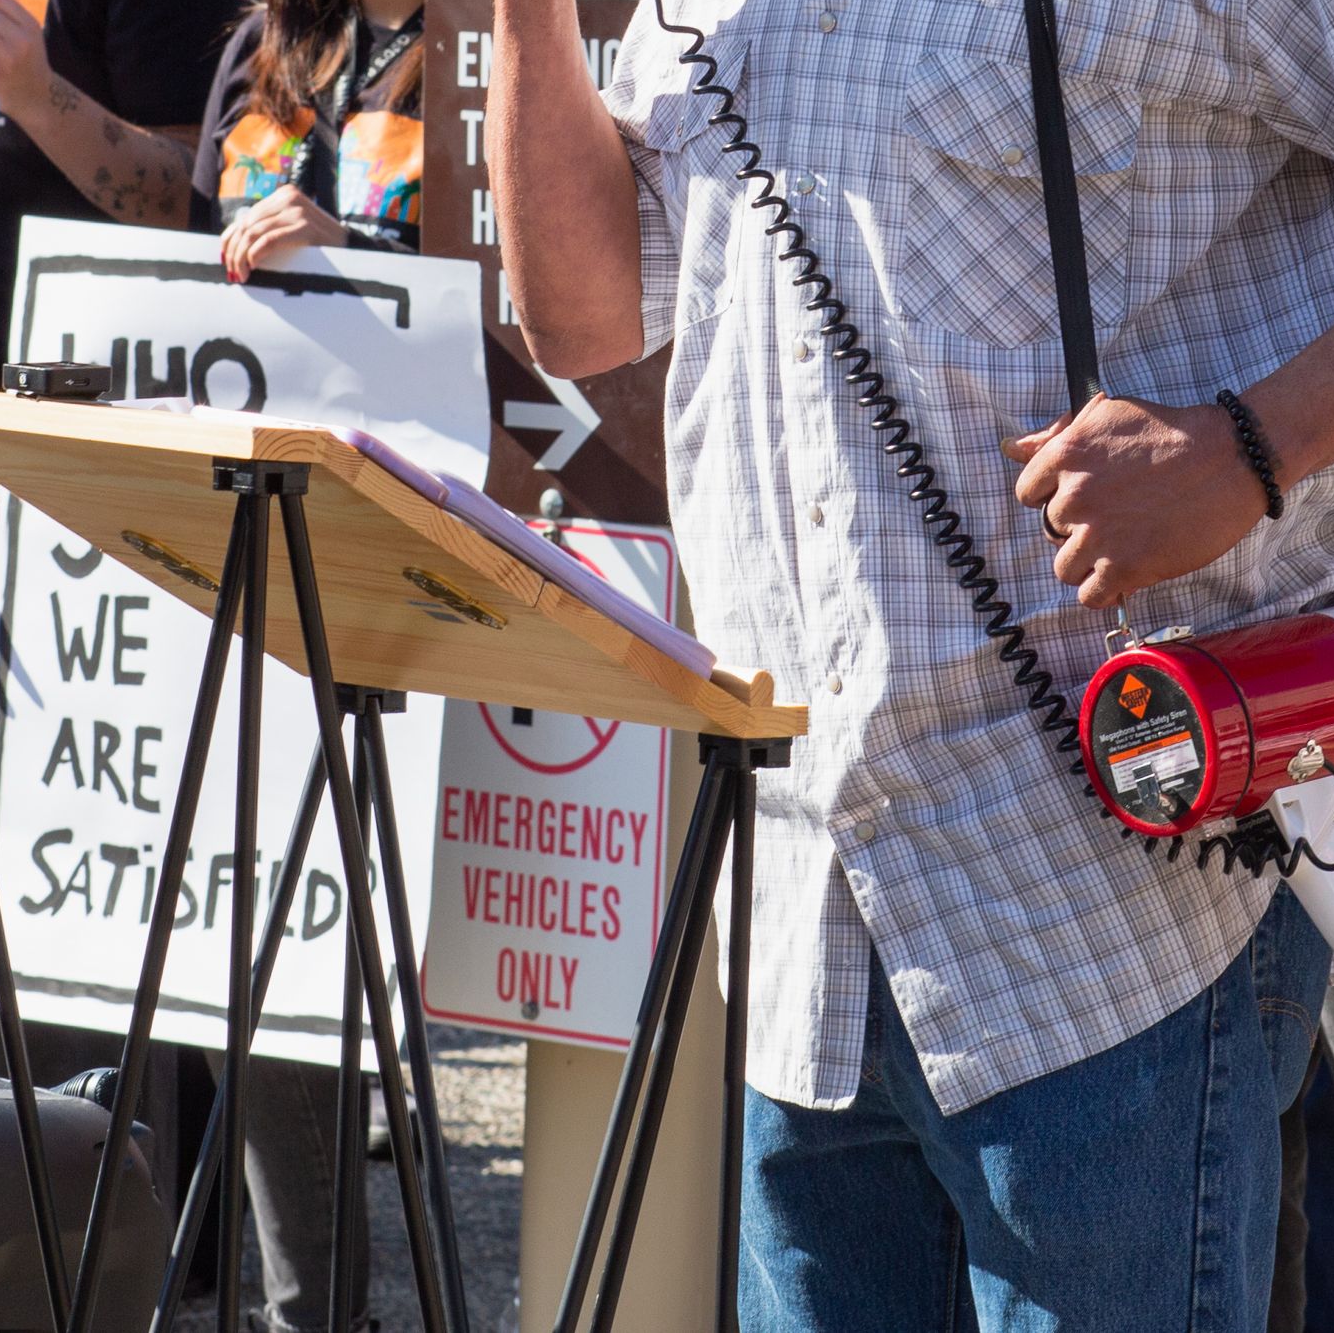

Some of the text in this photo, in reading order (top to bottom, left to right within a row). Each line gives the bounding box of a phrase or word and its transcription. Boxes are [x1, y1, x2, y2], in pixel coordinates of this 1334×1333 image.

[50, 592, 150, 686] WE
[41, 716, 163, 814] ARE
[1099, 726, 1136, 743] Megaphone
[443, 786, 649, 867] EMERGENCY
[463, 865, 622, 941] VEHICLES
[496, 948, 580, 1012] ONLY
